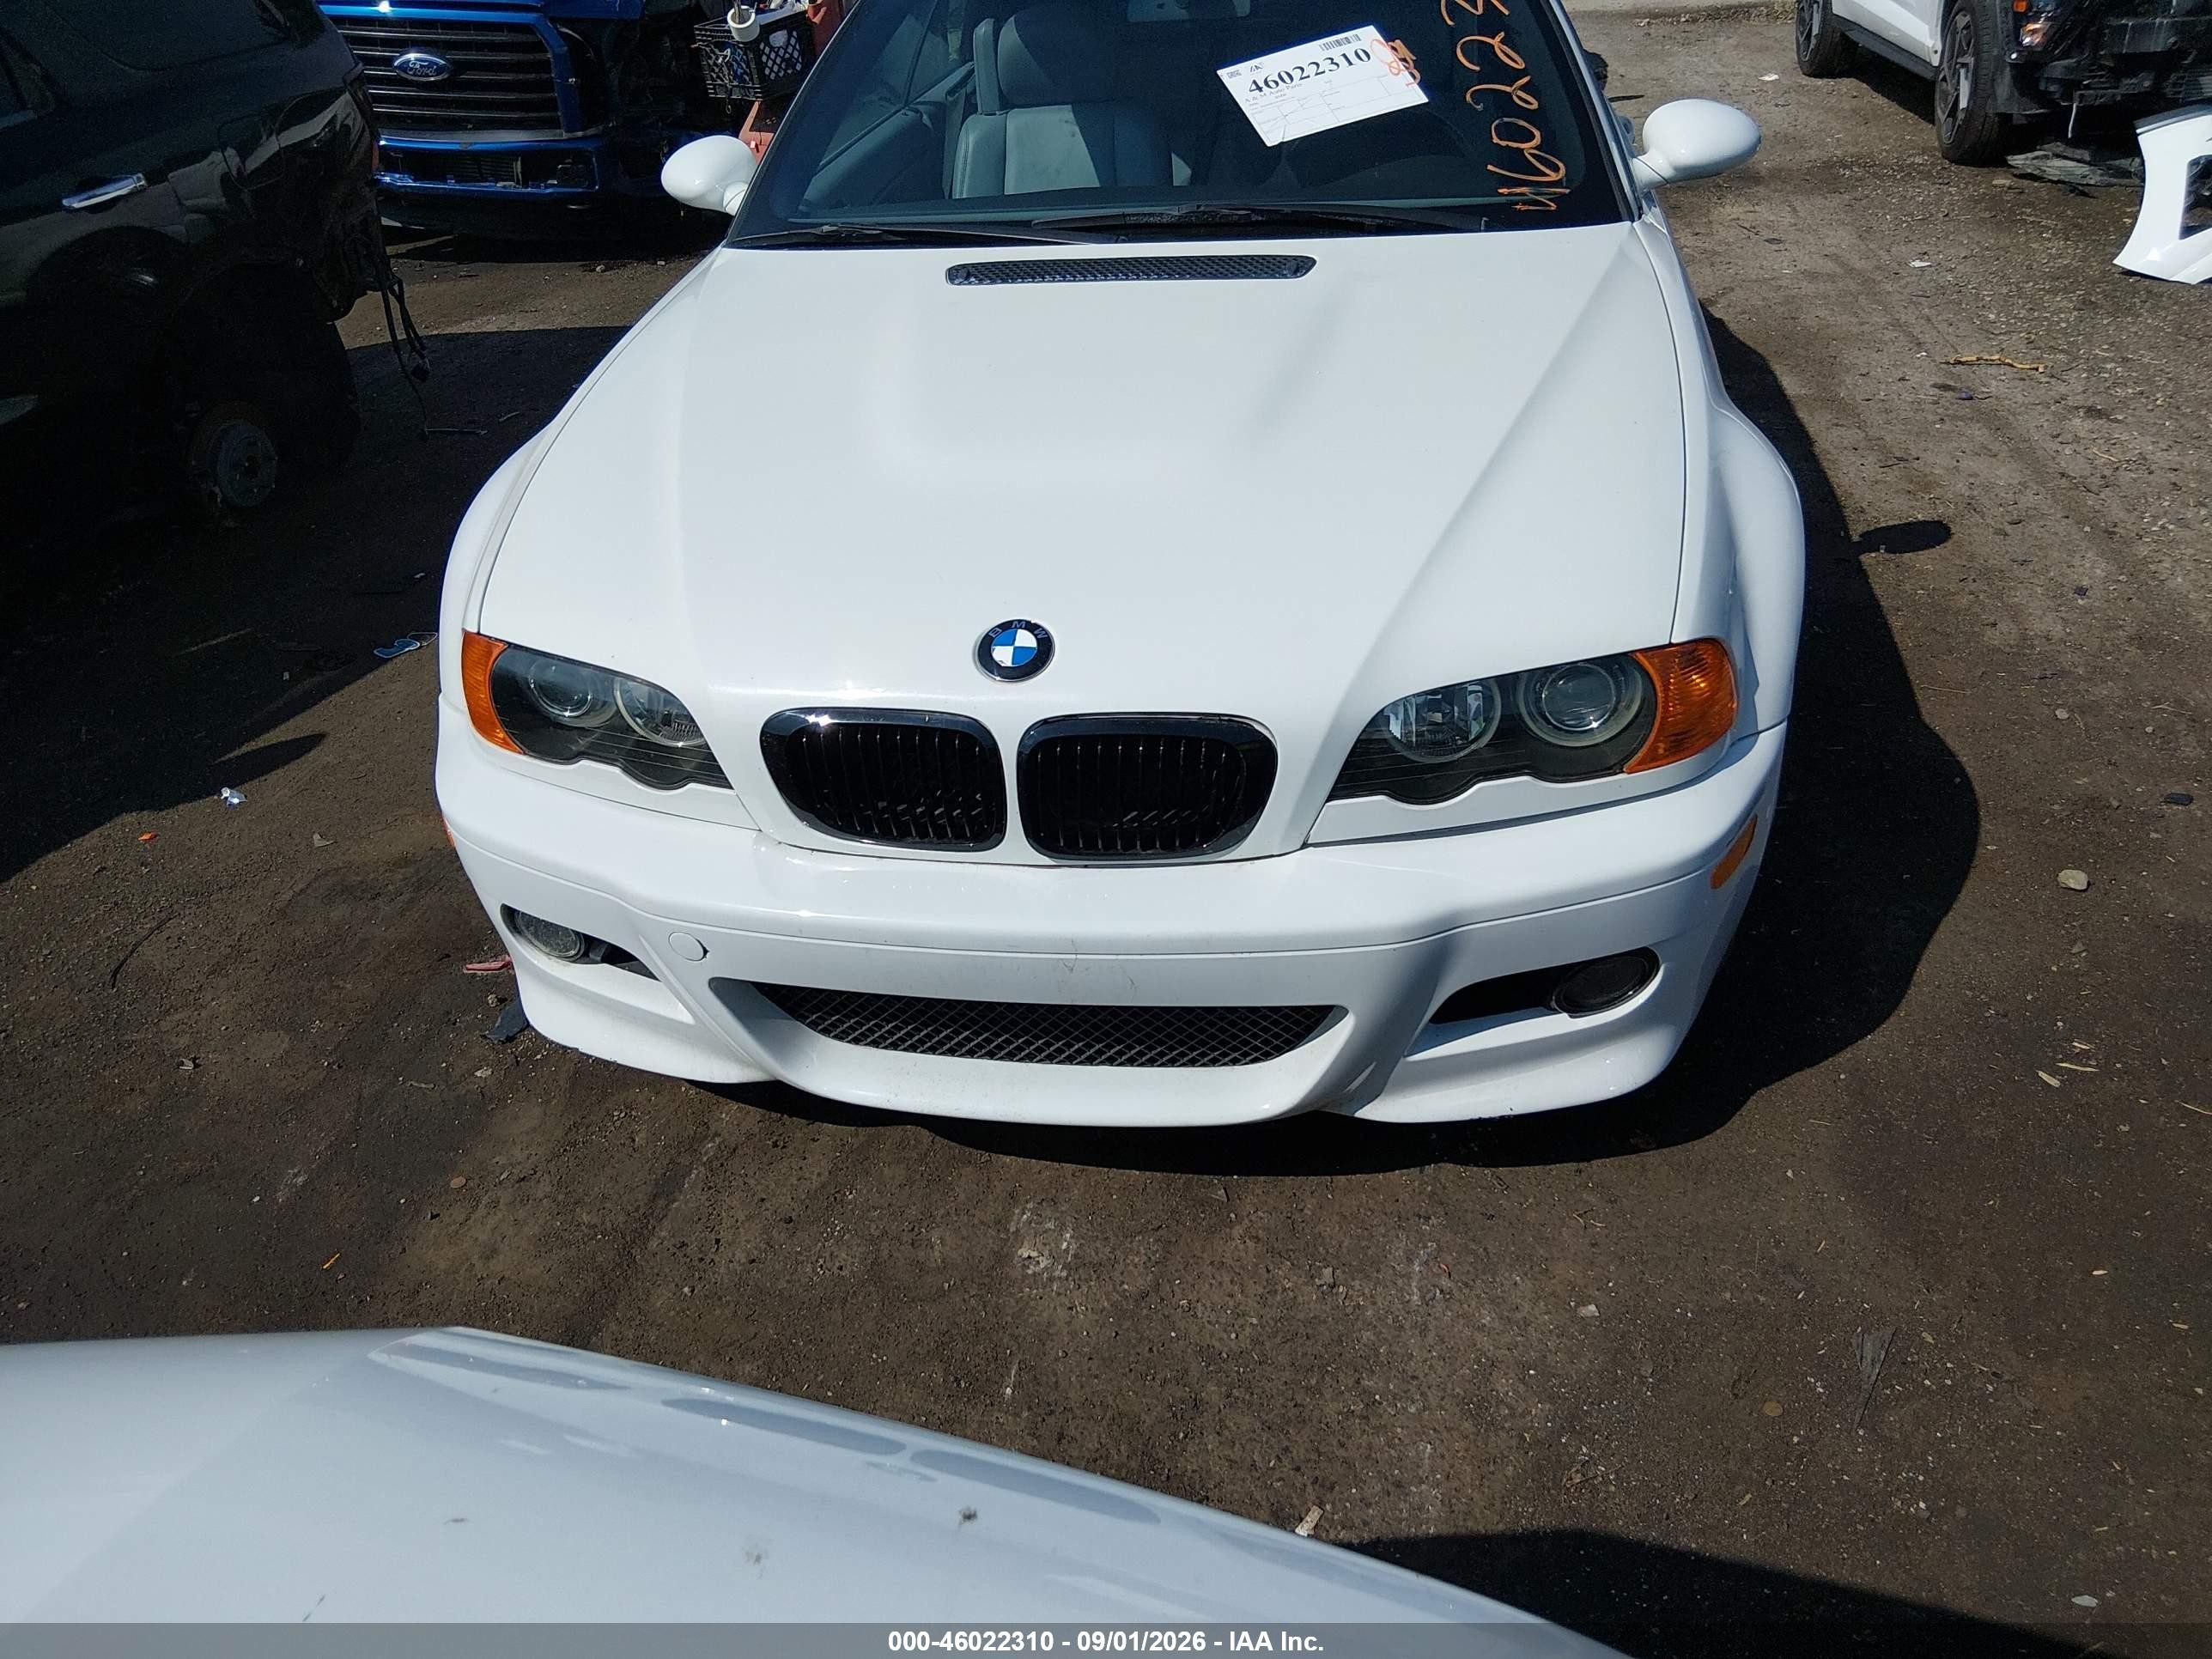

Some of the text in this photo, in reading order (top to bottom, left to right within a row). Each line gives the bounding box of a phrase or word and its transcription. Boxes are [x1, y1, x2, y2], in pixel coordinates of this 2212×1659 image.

[407, 60, 437, 76] Ford
[1249, 48, 1371, 93] 46022310
[989, 621, 1048, 639] BMW
